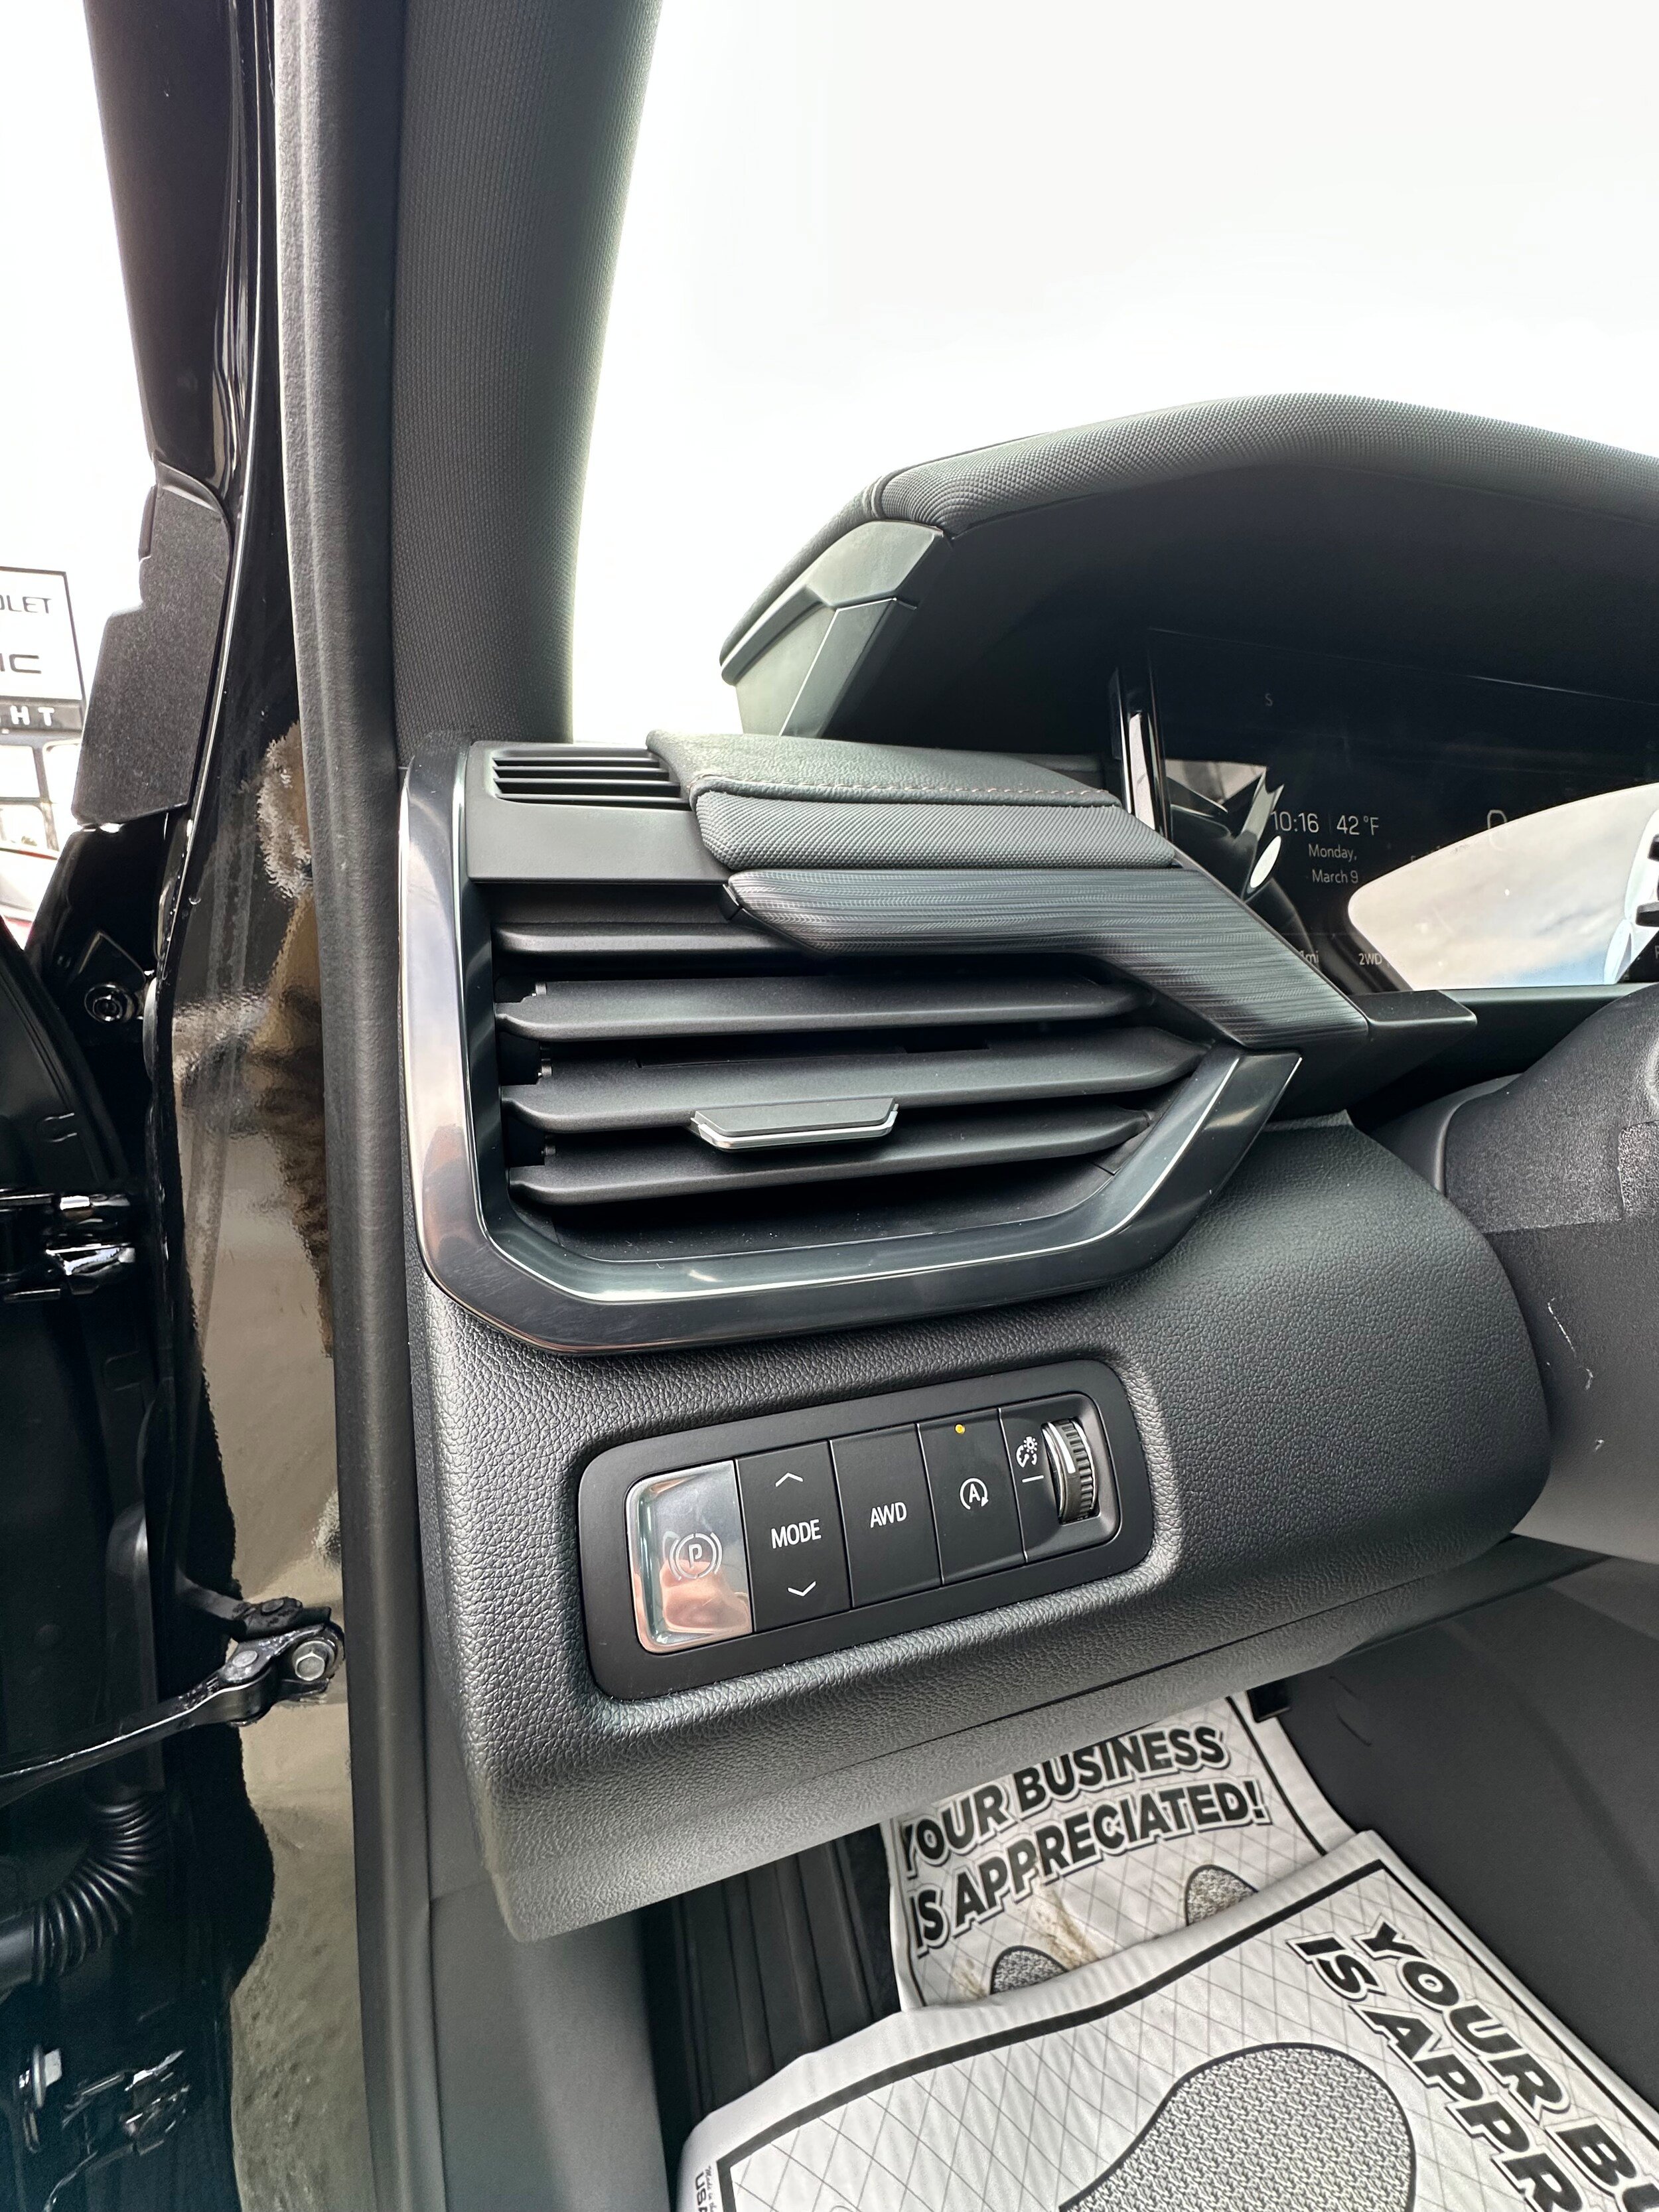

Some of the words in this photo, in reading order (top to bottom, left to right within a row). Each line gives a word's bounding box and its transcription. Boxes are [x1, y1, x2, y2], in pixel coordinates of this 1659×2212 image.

[1271, 810, 1320, 834] 10:16
[1309, 844, 1358, 862] Monday,
[1312, 869, 1348, 883] March
[1350, 870, 1359, 884] 9
[1358, 953, 1382, 966] 2WD
[869, 1502, 907, 1529] AWD
[770, 1518, 822, 1549] MODE
[901, 1784, 1010, 1872] YOUR
[1013, 1727, 1226, 1812] BUSINESS
[910, 1889, 944, 1949] IS
[956, 1781, 1265, 1928] APPRECIATED!
[1295, 1936, 1380, 1995] IS
[1356, 1921, 1564, 2110] YOUR
